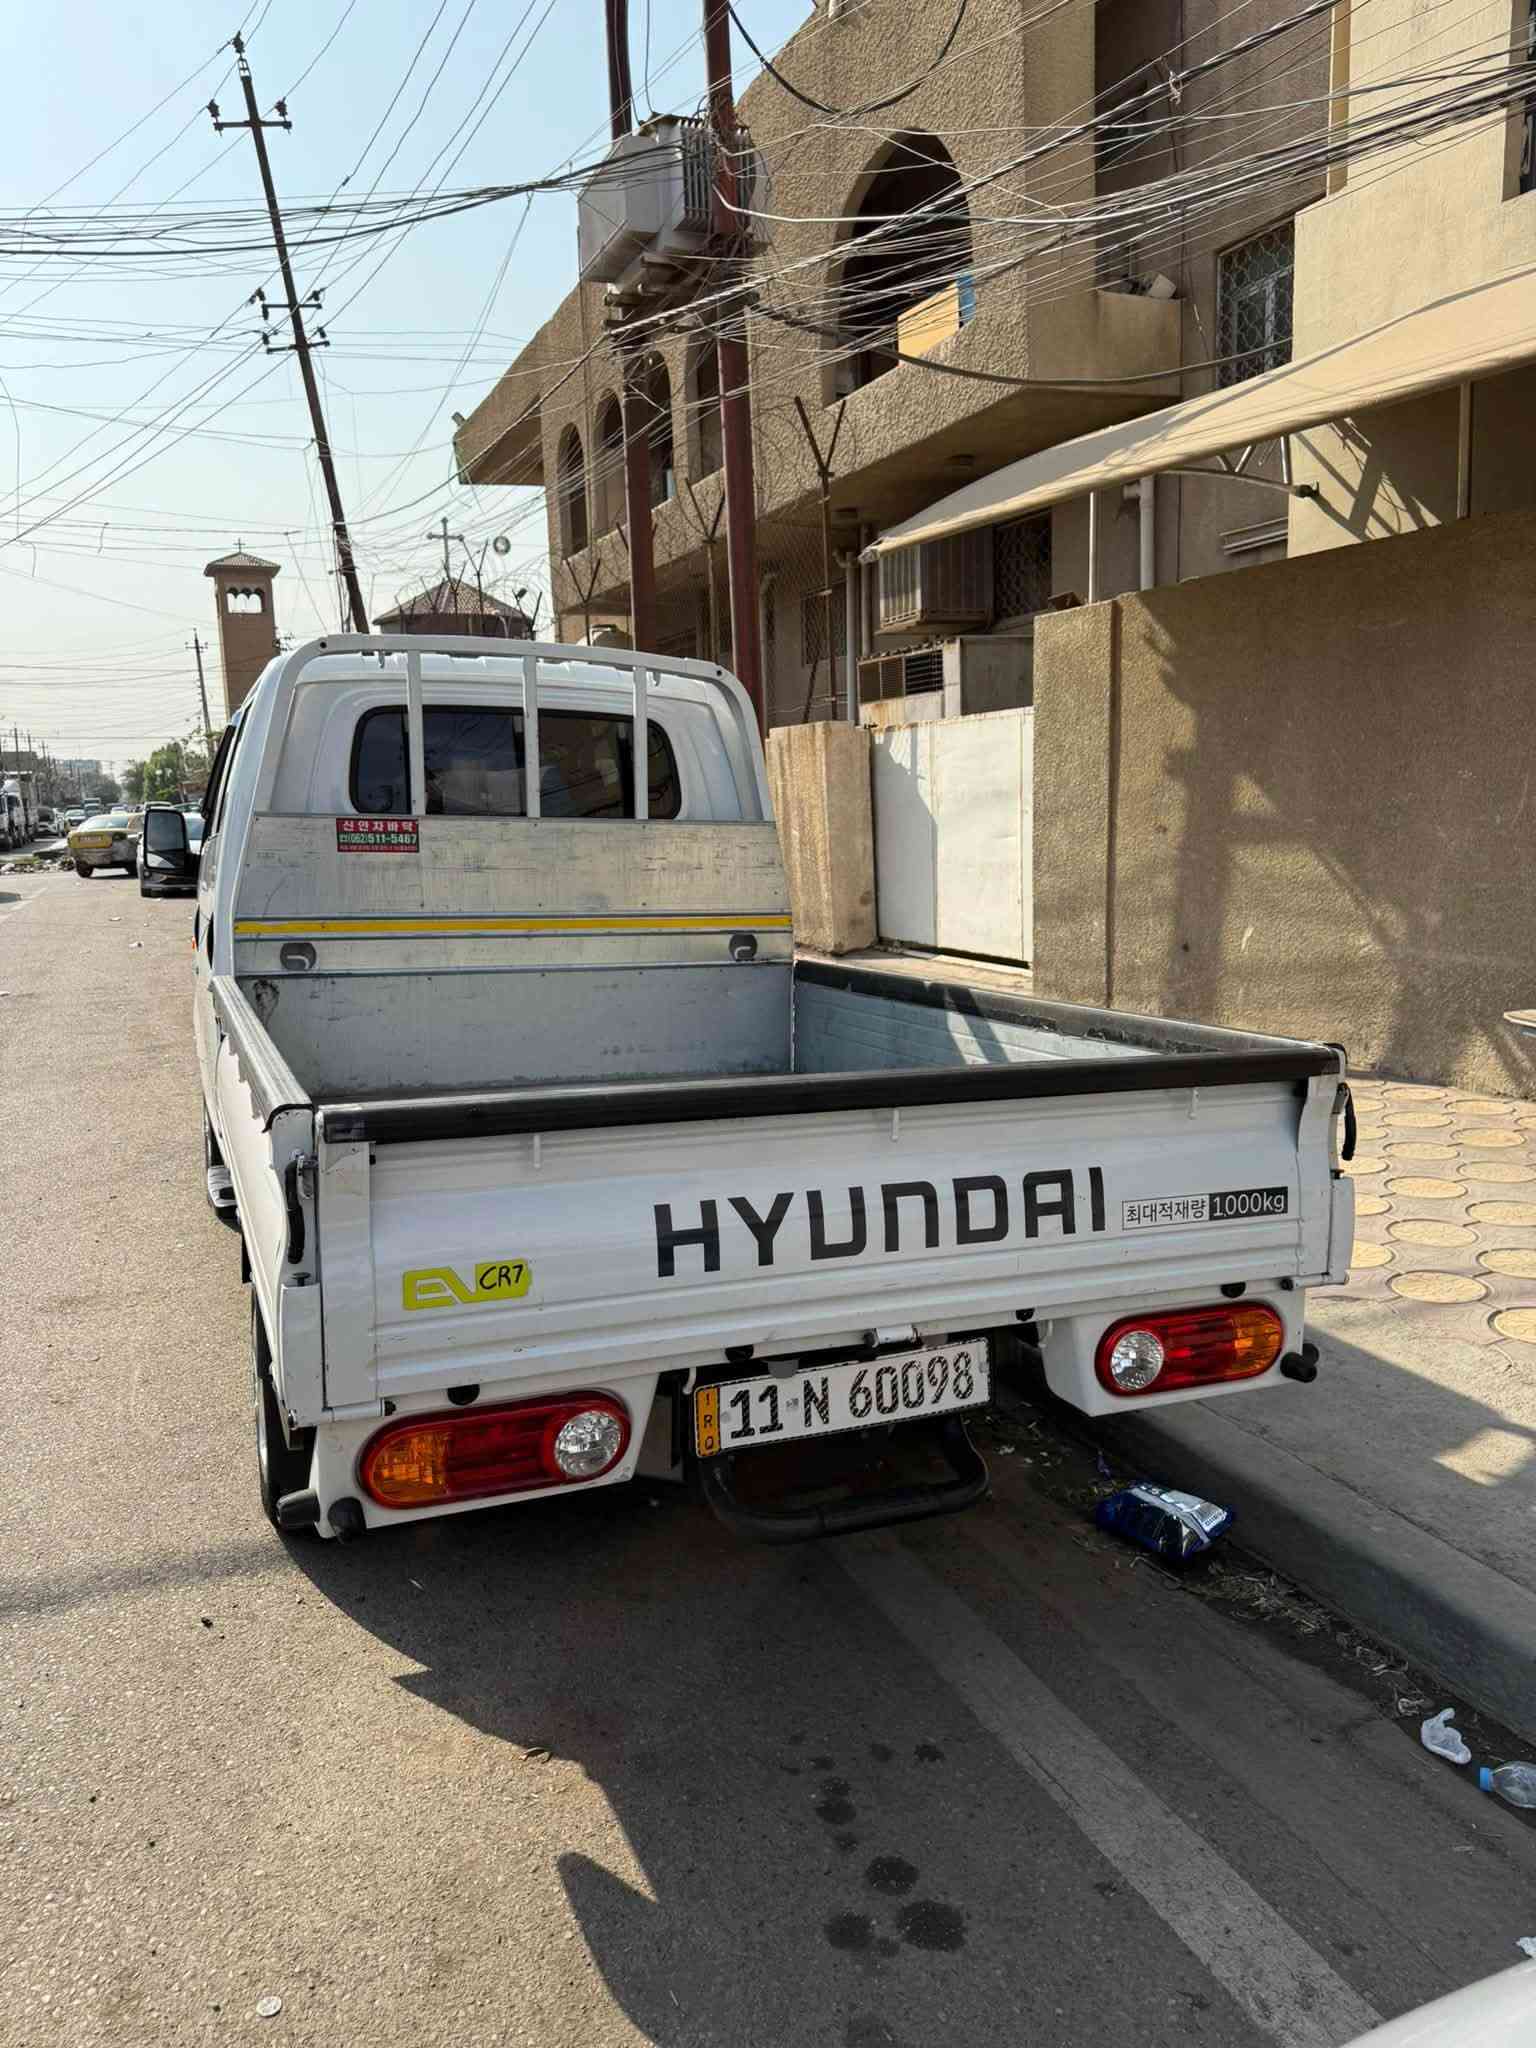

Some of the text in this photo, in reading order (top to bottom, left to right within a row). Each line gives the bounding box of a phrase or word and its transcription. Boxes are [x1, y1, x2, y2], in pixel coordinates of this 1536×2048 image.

[654, 1167, 1106, 1277] HYUNDAI
[1126, 1199, 1206, 1224] 최대적재량
[479, 1263, 524, 1290] CR7
[730, 1351, 974, 1440] 11 N 60098
